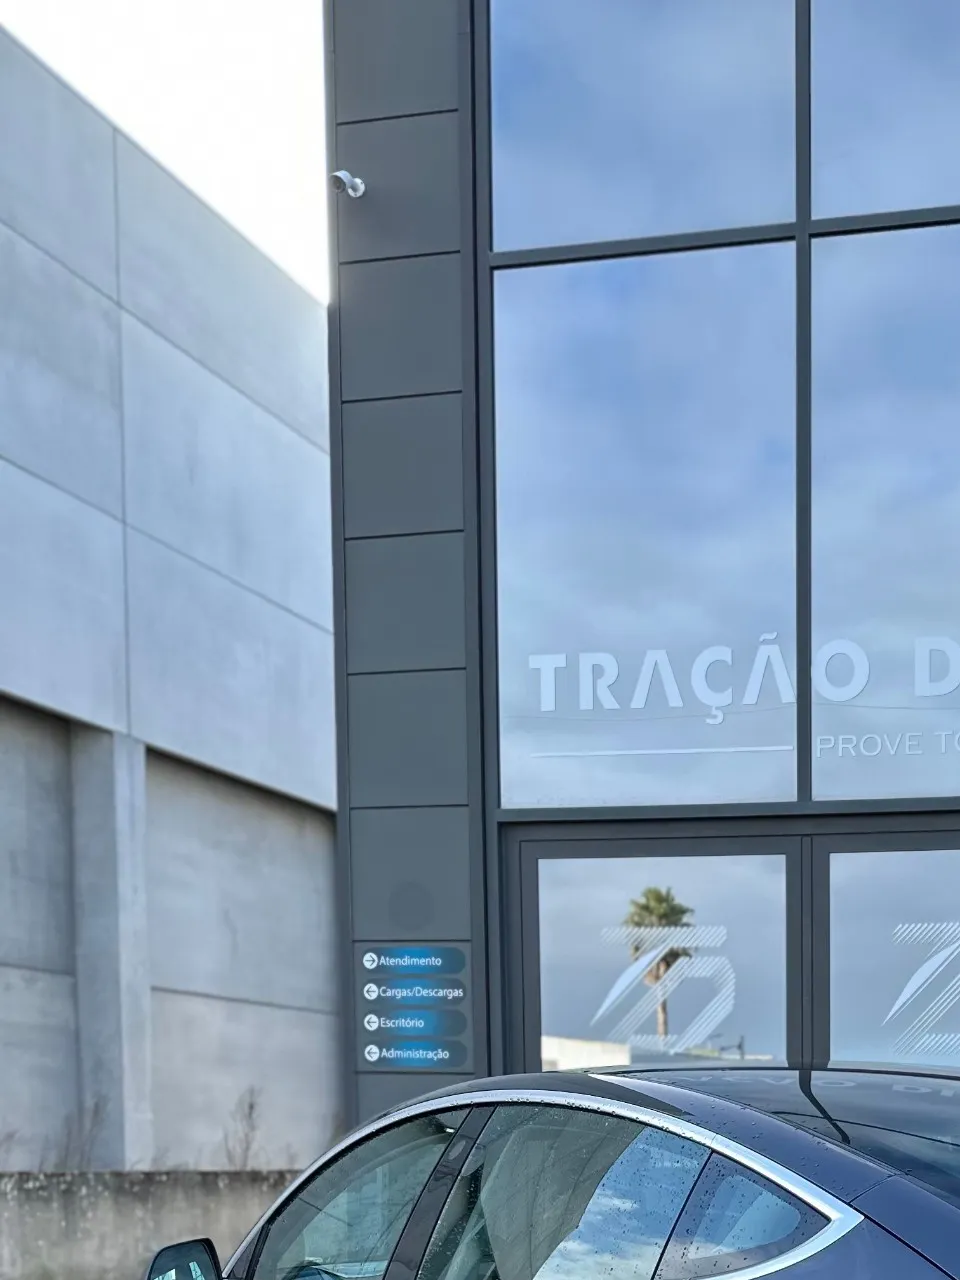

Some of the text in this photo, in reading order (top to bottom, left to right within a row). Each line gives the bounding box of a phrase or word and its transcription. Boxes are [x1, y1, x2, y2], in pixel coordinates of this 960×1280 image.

[528, 631, 870, 725] TRAÇÃO
[816, 732, 923, 758] PROVE
[378, 955, 442, 966] Atendimento
[379, 986, 464, 999] Cargas/Descargas
[380, 1017, 425, 1028] Escritório
[381, 1048, 449, 1061] Administração
